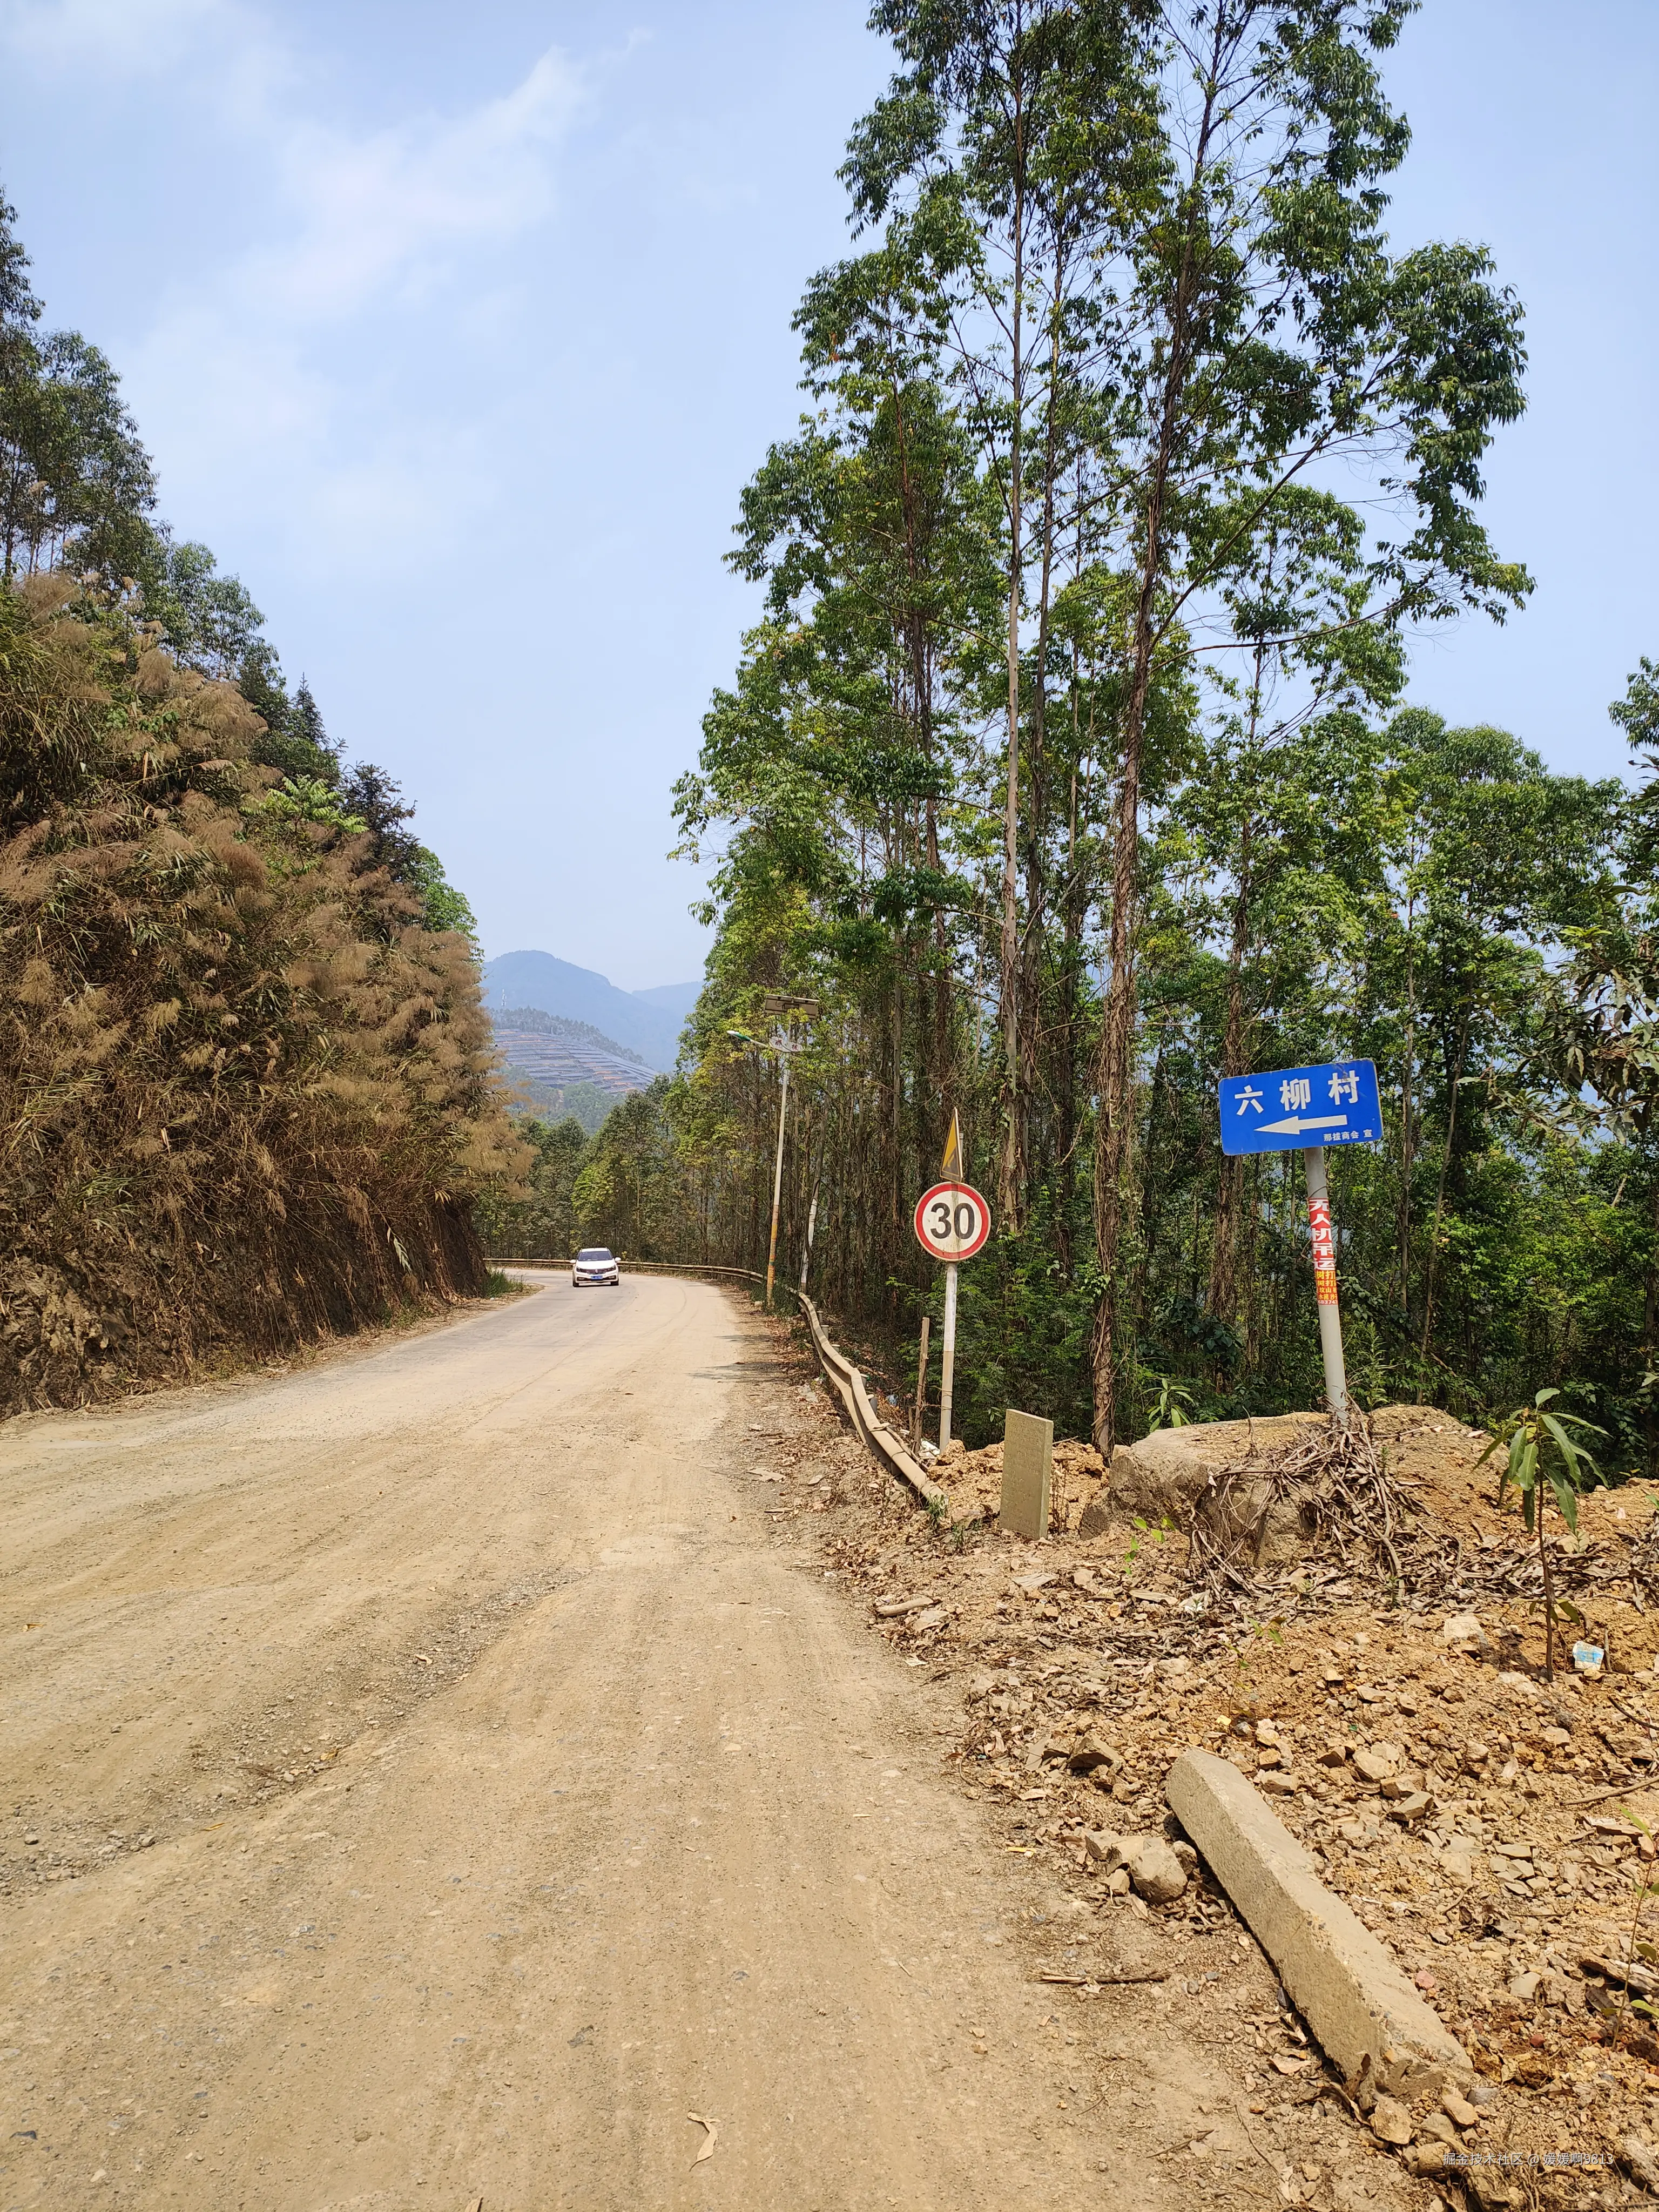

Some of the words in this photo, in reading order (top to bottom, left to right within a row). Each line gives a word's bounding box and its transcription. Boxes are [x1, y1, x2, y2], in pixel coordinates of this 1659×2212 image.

[1235, 1070, 1360, 1116] 六柳村
[930, 1202, 975, 1239] 30
[1309, 1199, 1336, 1271] 无人机吊运
